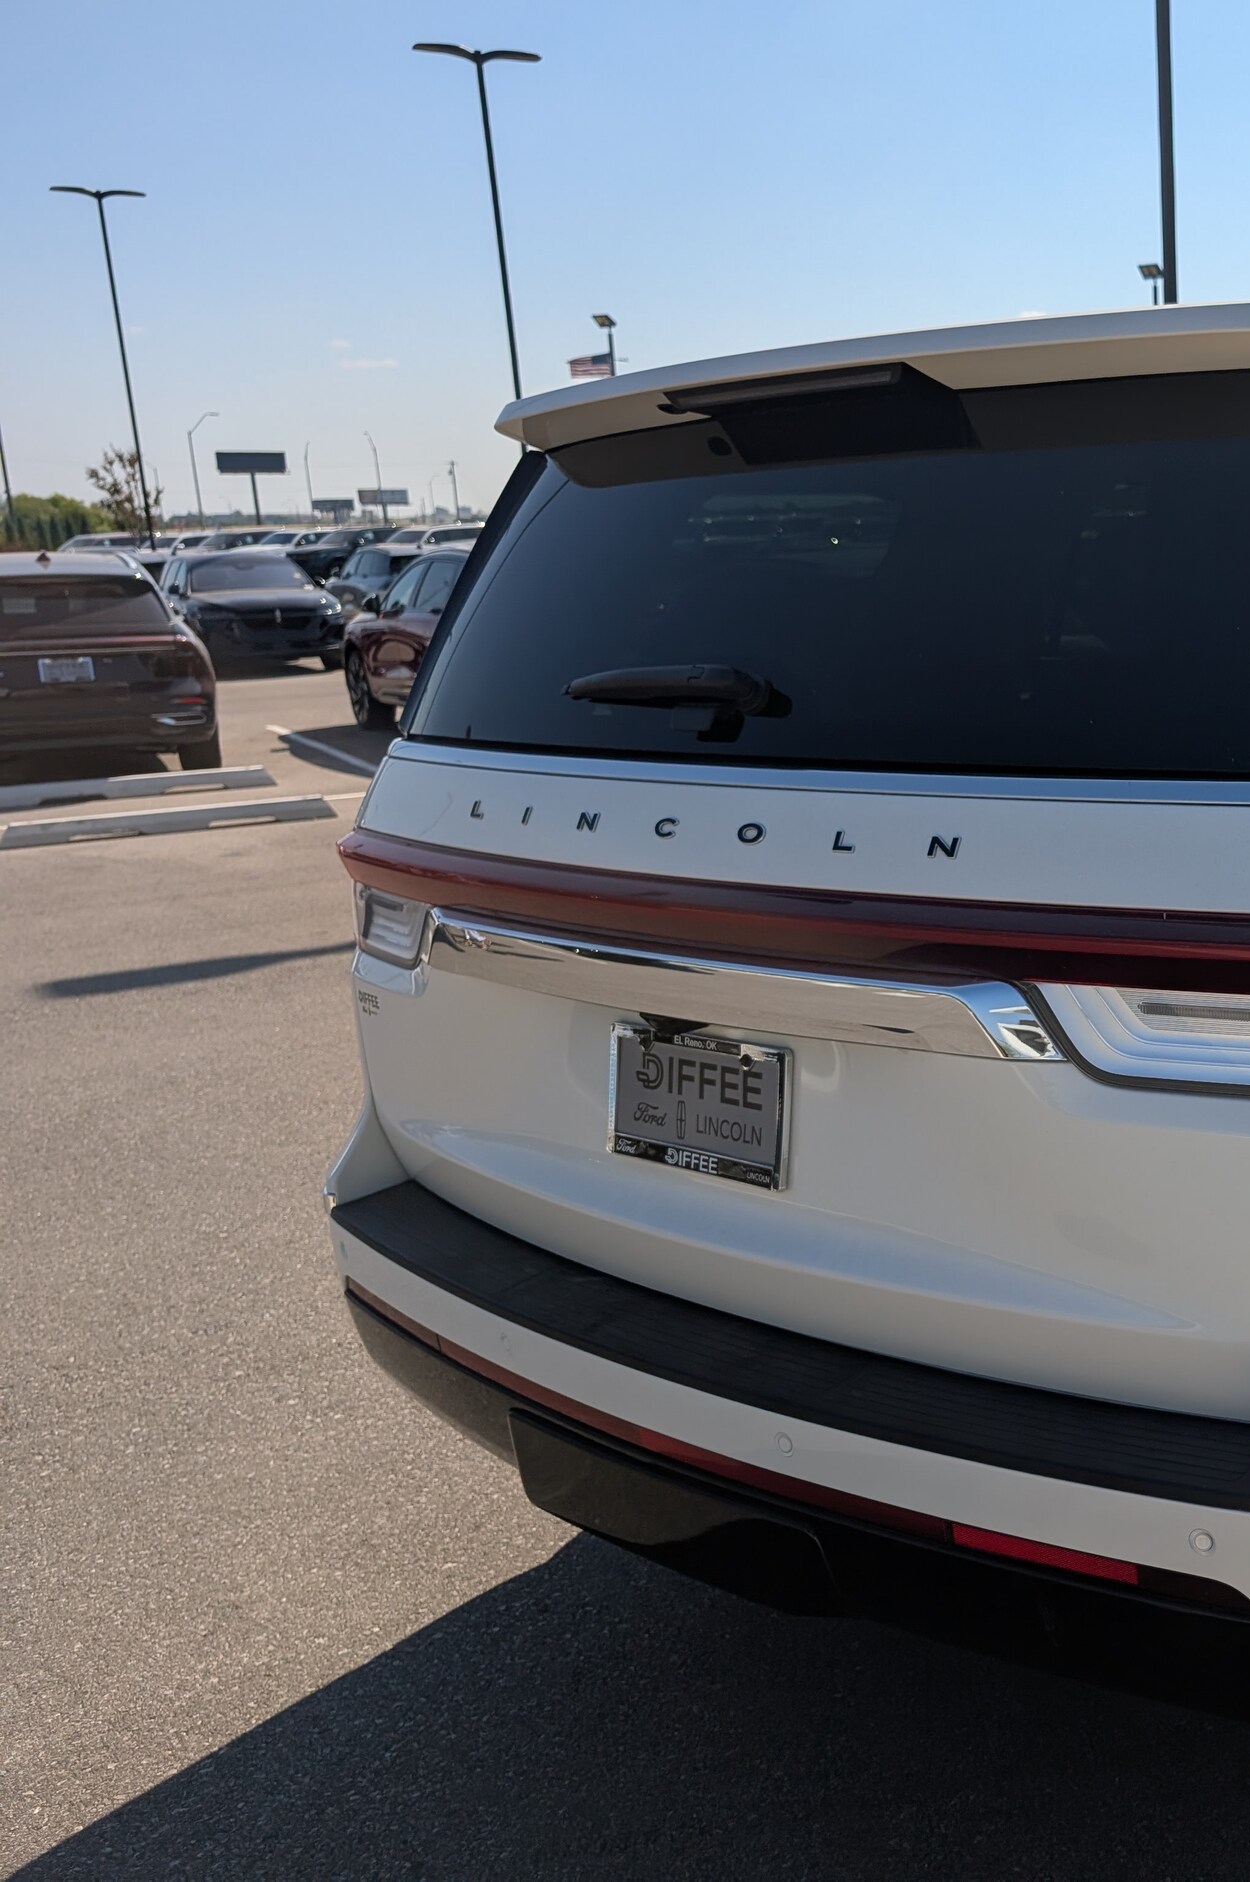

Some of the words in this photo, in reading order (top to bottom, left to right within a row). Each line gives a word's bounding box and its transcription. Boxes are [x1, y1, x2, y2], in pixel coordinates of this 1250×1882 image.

[470, 800, 963, 859] LINCOLN
[673, 1034, 683, 1045] EL
[705, 1039, 718, 1051] OK
[635, 1051, 763, 1111] DIFFEE
[633, 1101, 668, 1127] Ford
[695, 1113, 763, 1147] LINCOLN
[616, 1138, 637, 1155] Ford
[664, 1147, 719, 1175] DIFFEE
[746, 1169, 771, 1184] LINCOLN
